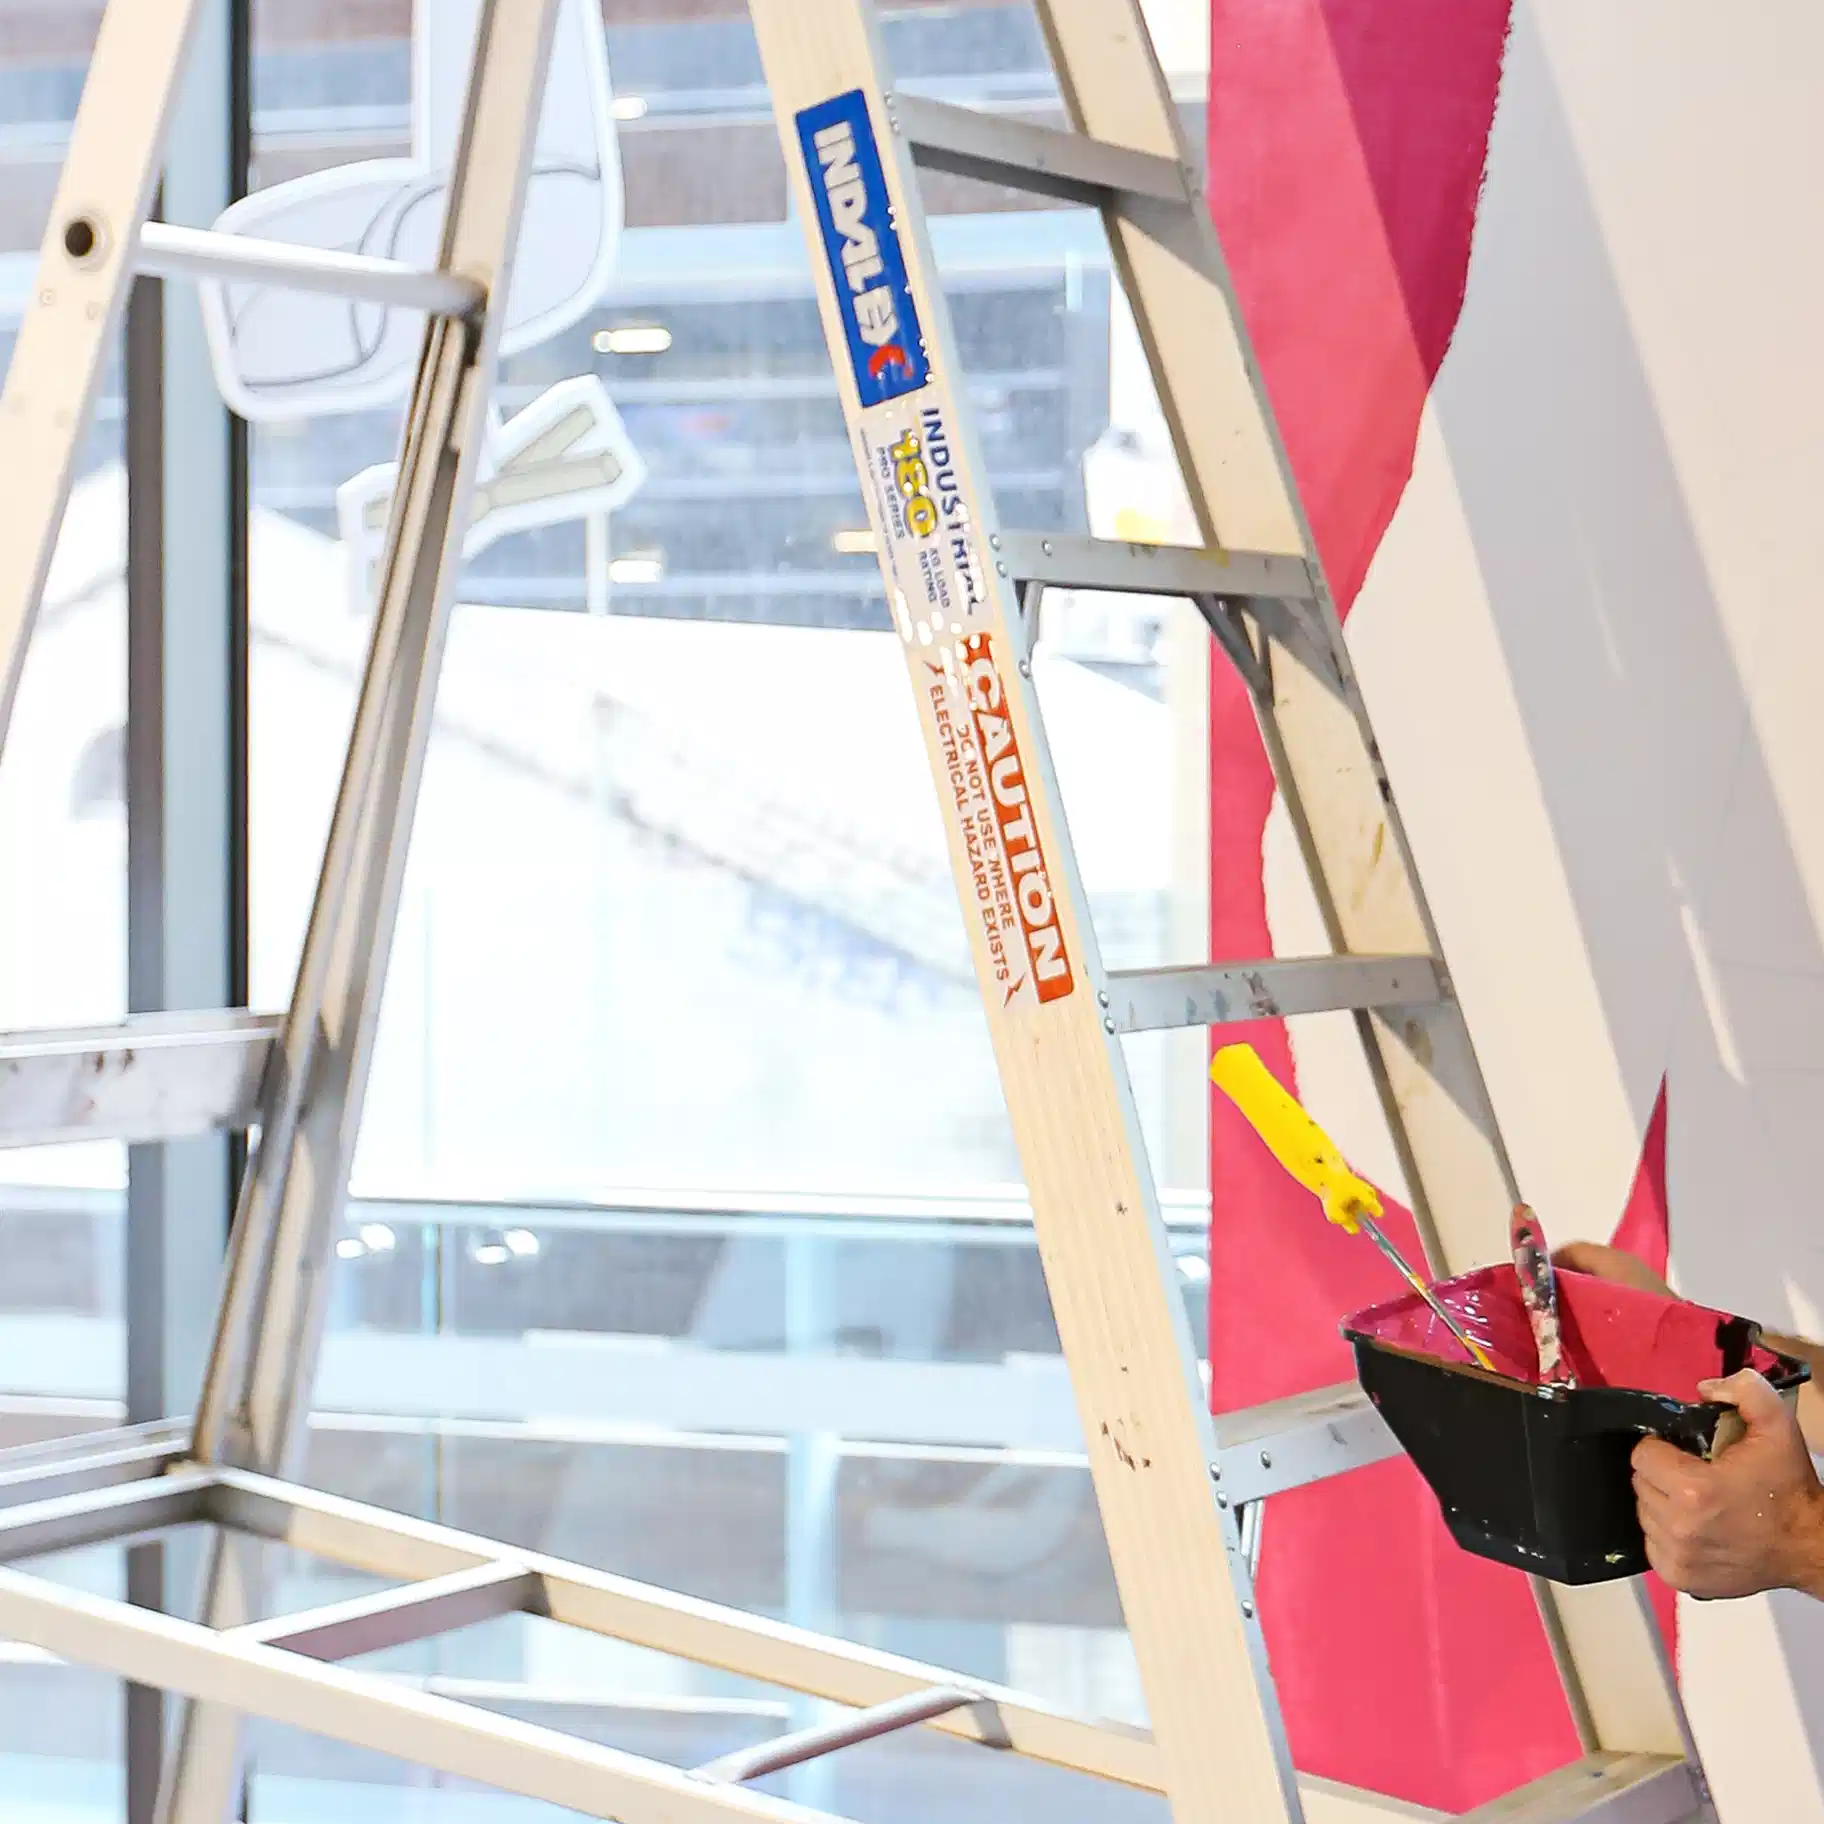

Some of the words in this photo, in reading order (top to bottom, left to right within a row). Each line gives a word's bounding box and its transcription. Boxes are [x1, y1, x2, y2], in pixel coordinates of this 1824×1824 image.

[813, 120, 915, 381] INDALEX
[929, 684, 972, 813] ELECTRICAL
[960, 815, 991, 902] HAZARD
[981, 905, 1011, 982] EXISTS
[963, 758, 987, 803] NOT
[967, 656, 1068, 983] CAUTION
[974, 807, 998, 853] USE
[986, 858, 1017, 932] WHERE
